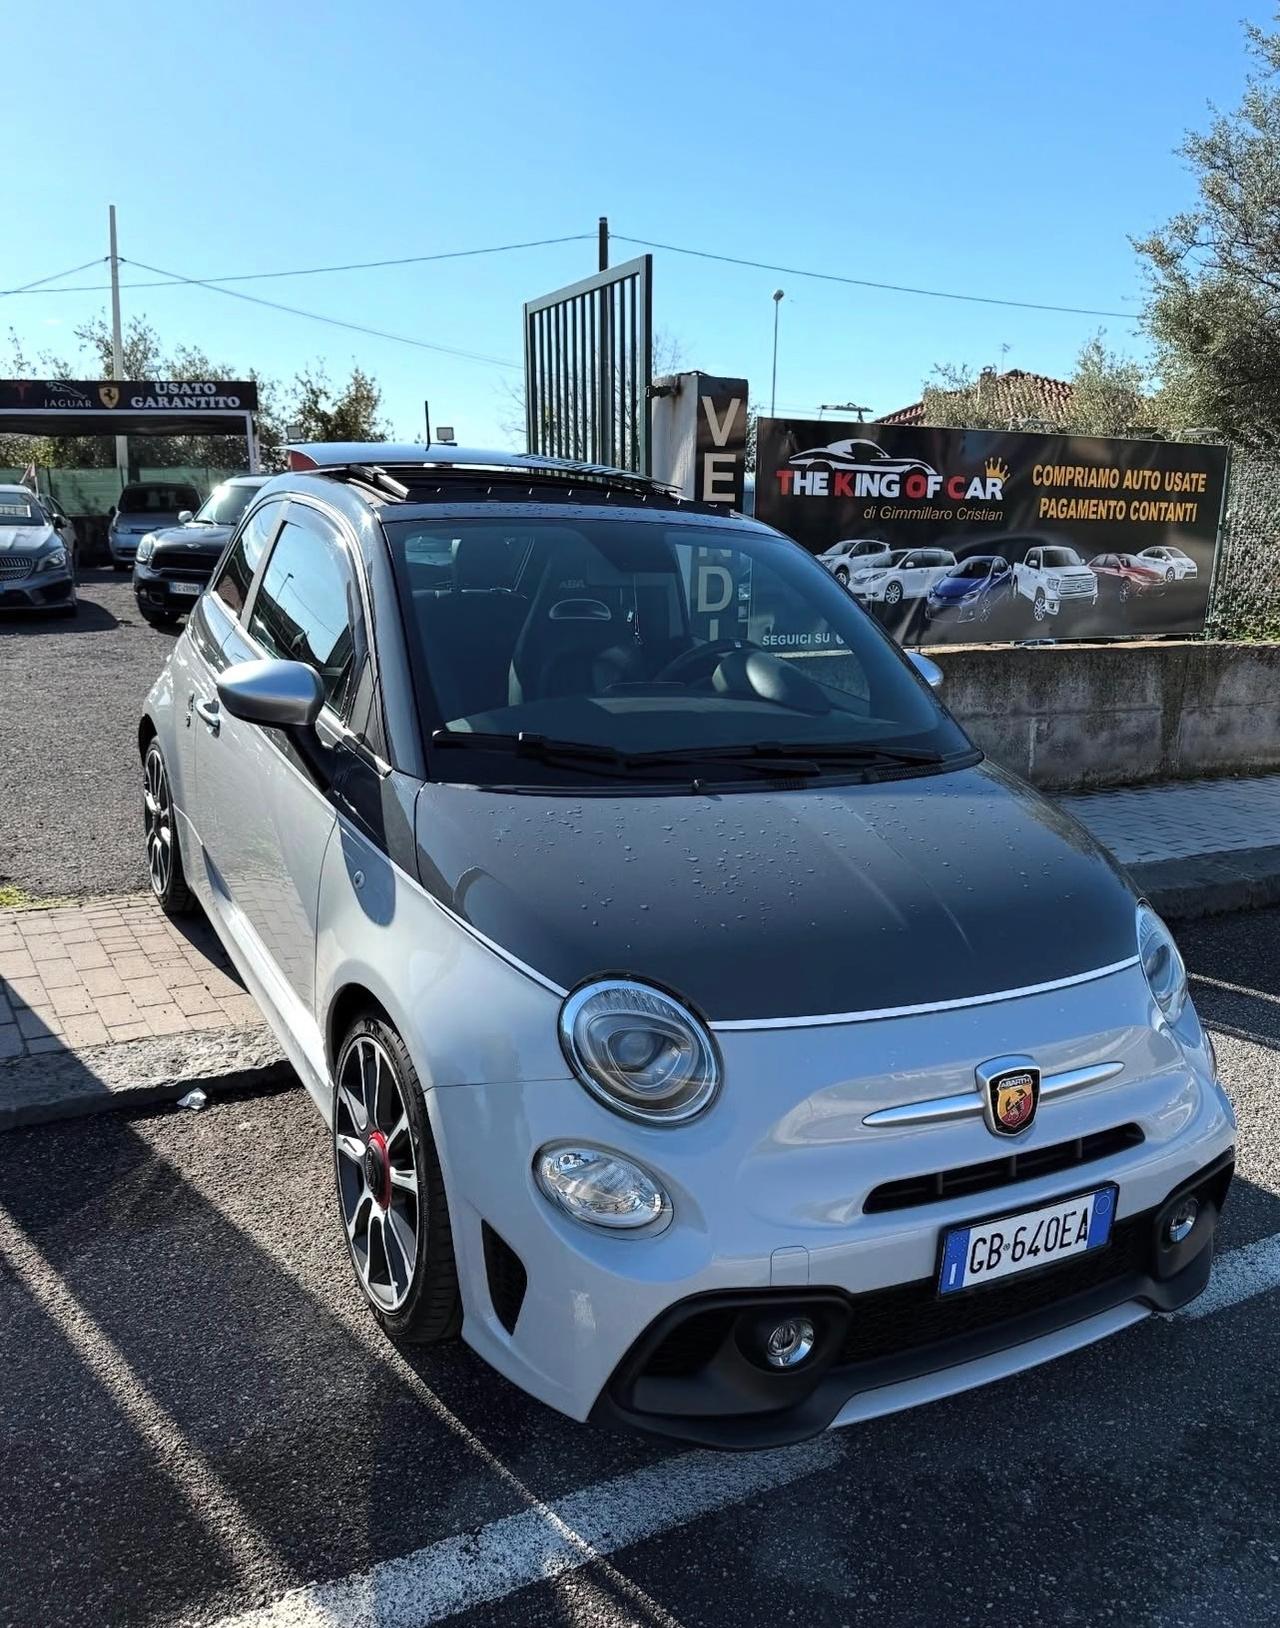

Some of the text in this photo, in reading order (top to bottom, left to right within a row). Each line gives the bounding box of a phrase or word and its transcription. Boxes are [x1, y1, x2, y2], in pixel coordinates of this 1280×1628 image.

[155, 382, 216, 395] USATO
[44, 399, 92, 409] JAGUAR
[131, 396, 240, 409] GARANTITO
[776, 470, 1003, 500] THE KING OF CAR
[1032, 464, 1207, 493] COMPRIAMO AUTO USATE
[863, 506, 1003, 521] di Gimmillaro Cristian
[1039, 497, 1197, 522] PAGAMENTO CONTANTI
[762, 632, 830, 646] SEGUICI SU
[1001, 1077, 1031, 1088] ABARTH
